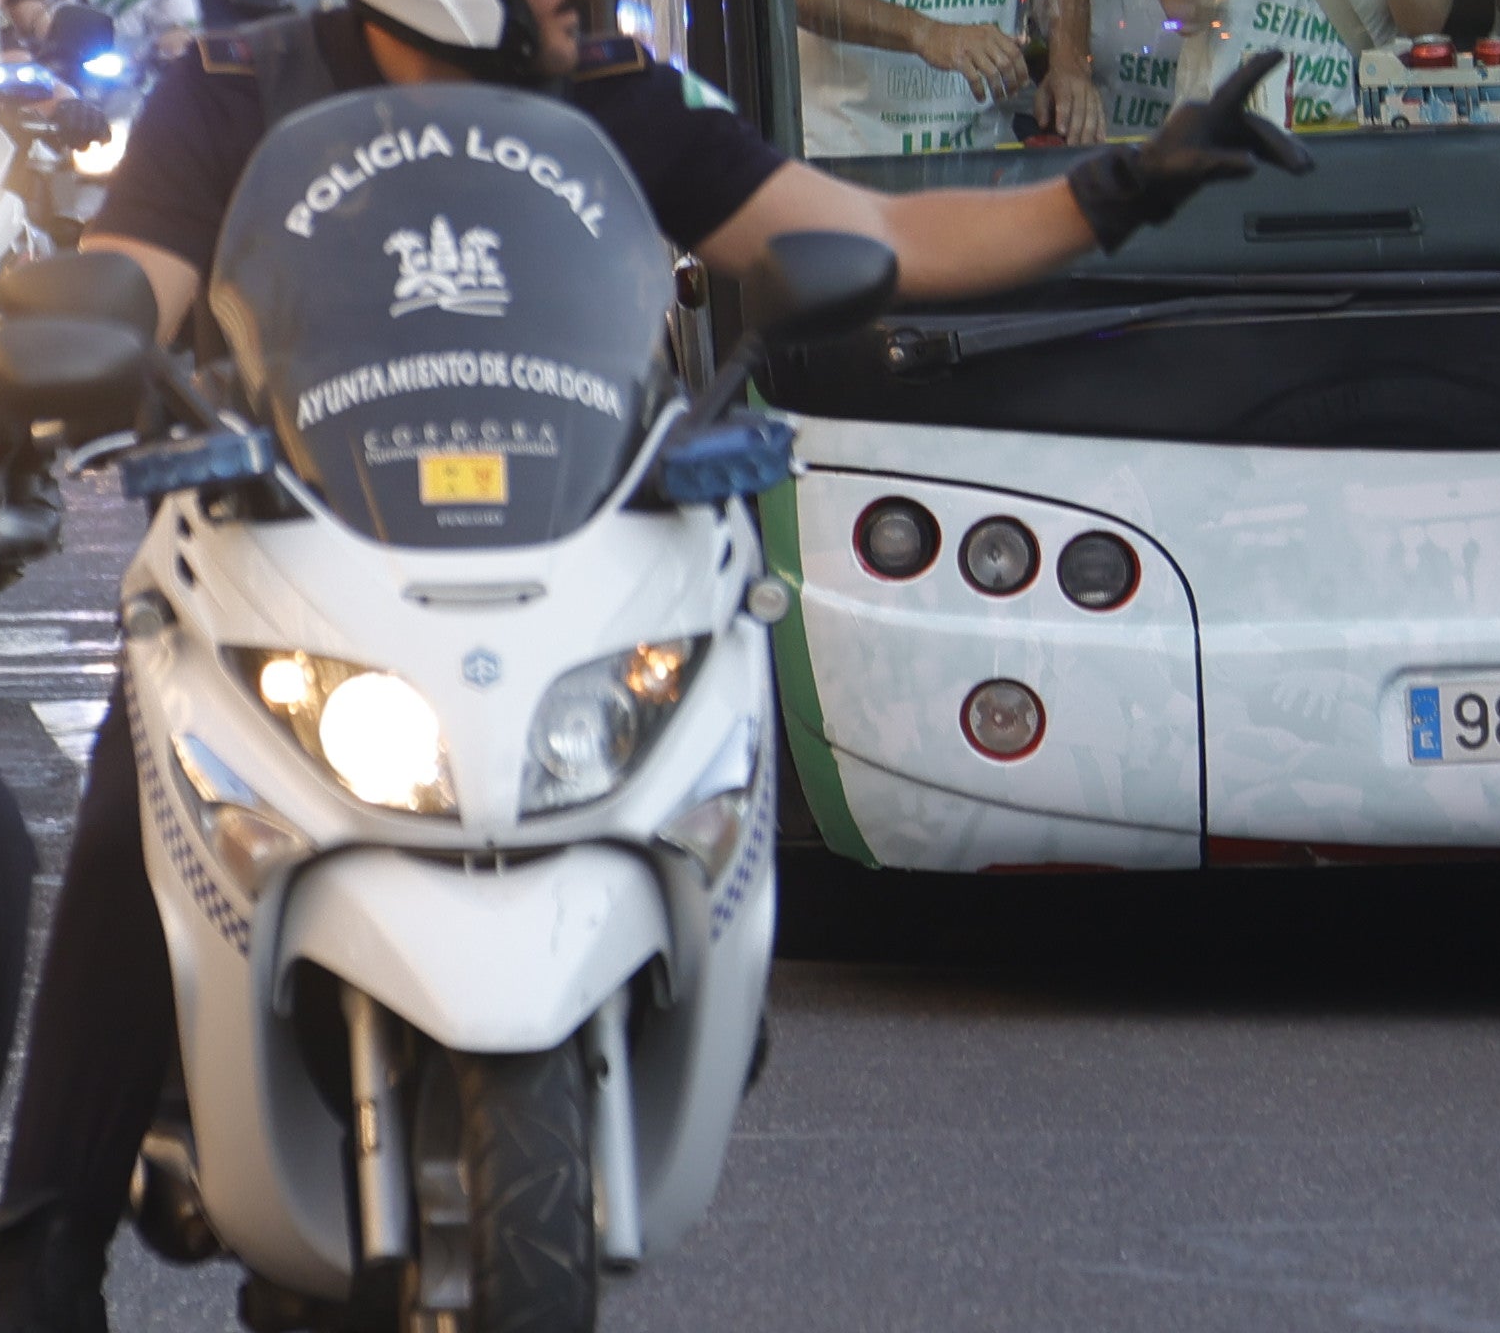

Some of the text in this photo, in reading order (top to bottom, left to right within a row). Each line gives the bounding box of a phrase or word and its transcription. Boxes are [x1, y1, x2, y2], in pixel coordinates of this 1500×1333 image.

[285, 123, 606, 239] POLICIA LOCAL
[297, 352, 624, 431] AYUNTAMIENTO DE CORDOBA
